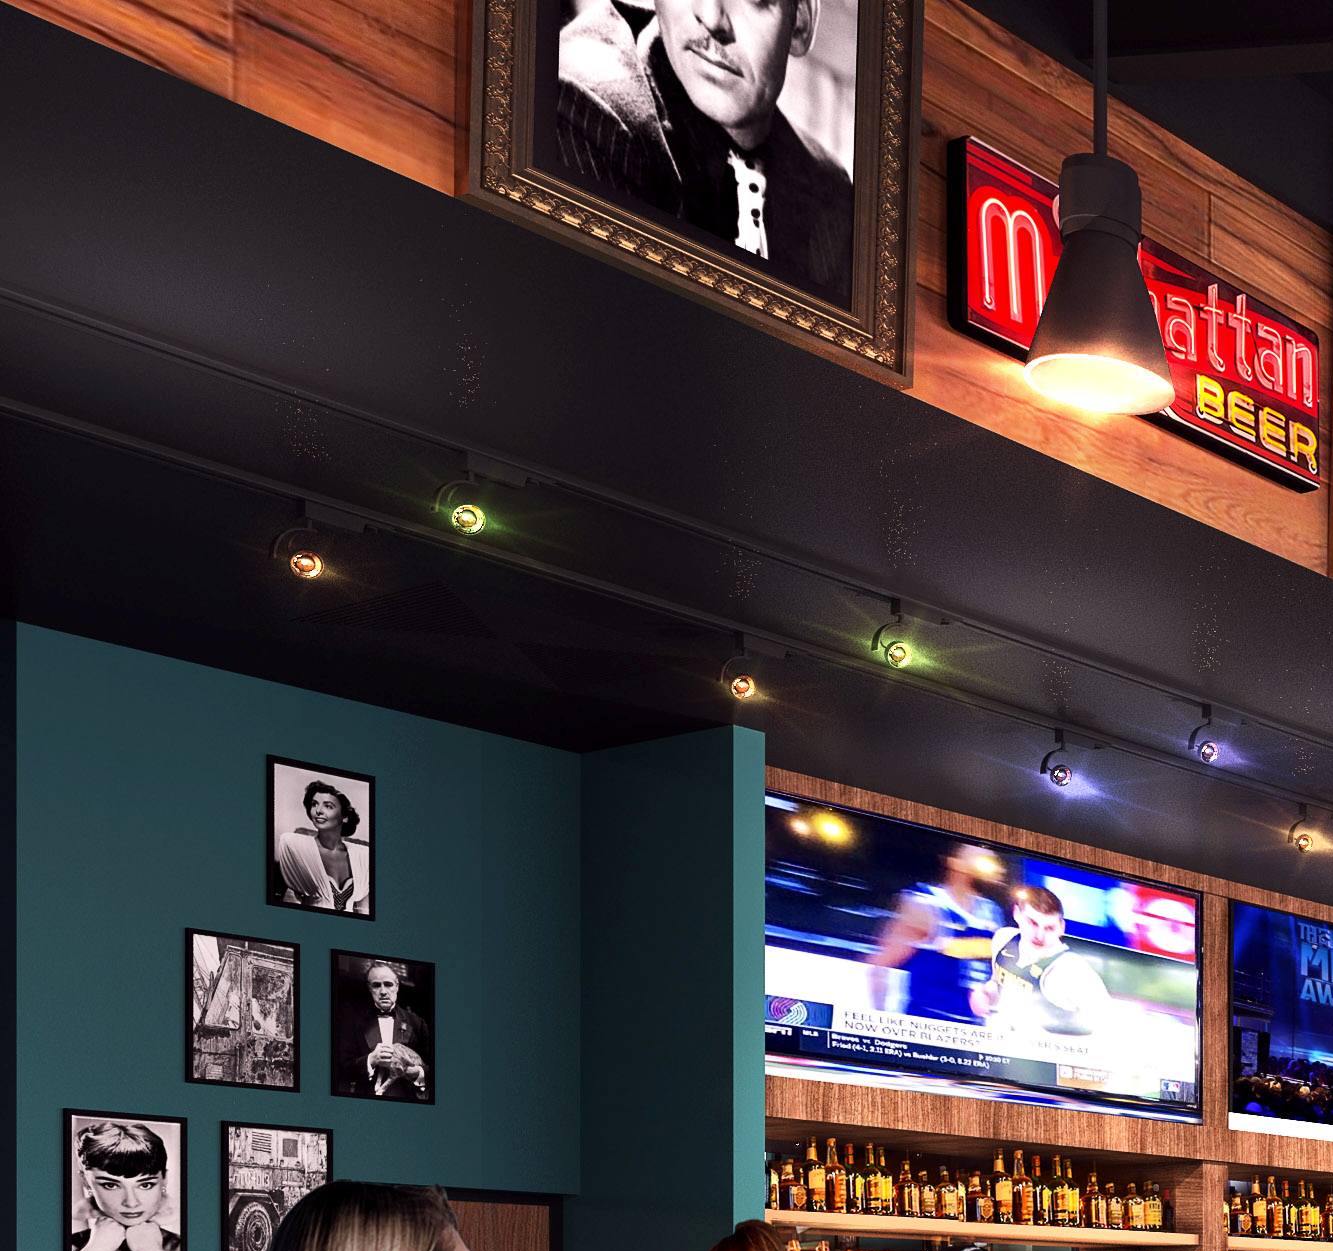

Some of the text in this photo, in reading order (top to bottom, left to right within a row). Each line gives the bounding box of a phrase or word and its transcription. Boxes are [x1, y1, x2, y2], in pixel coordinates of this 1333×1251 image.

[978, 197, 1314, 407] Mattan
[1195, 374, 1319, 474] BEER
[844, 1020, 879, 1033] NOW
[881, 1026, 917, 1038] OVER
[845, 1011, 873, 1022] FEEL
[879, 1016, 904, 1027] LIKE
[909, 1021, 968, 1036] NUGGETS
